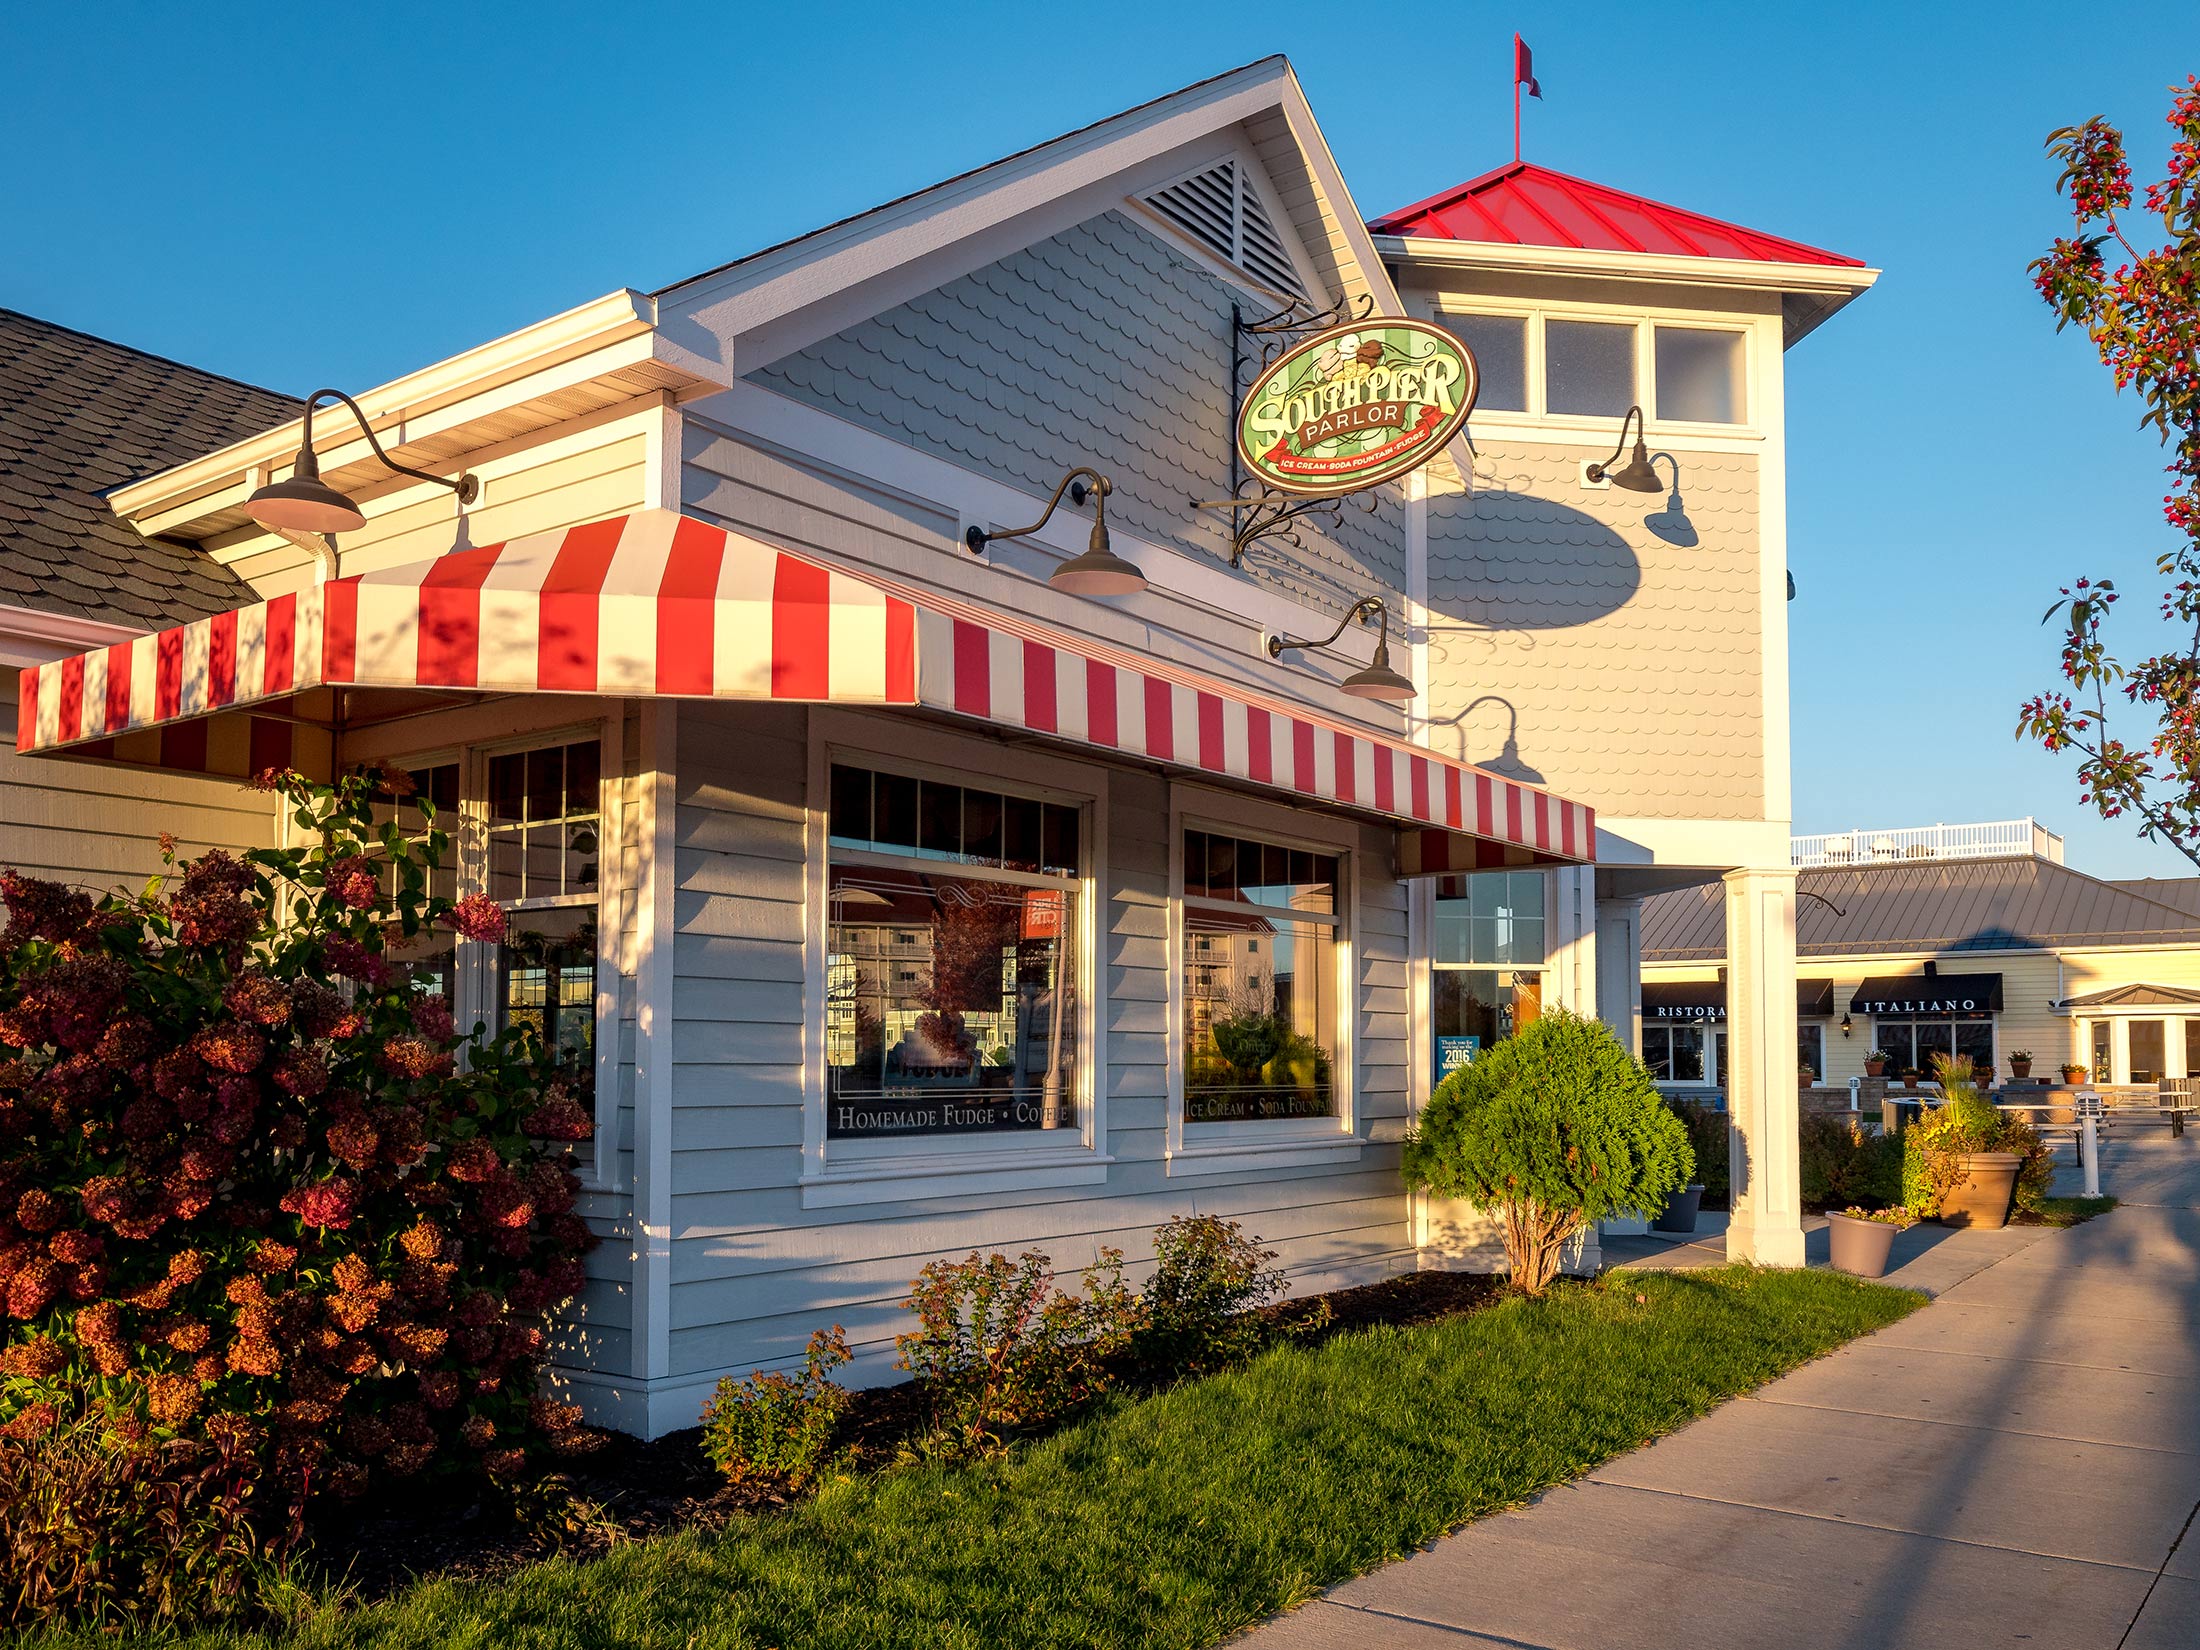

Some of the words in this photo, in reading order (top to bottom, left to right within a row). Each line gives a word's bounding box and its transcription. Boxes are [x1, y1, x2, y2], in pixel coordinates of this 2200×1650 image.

[1250, 379, 1363, 462] SOUTH
[1365, 353, 1461, 416] PIER
[1305, 404, 1398, 442] PARLOR
[1281, 459, 1295, 468] ICE
[1352, 447, 1394, 467] FOUNTAIN
[1396, 429, 1427, 450] FUDGE
[1863, 999, 1976, 1013] ITALIANO
[1445, 1049, 1470, 1063] 2016
[837, 1106, 937, 1130] HOMEMADE
[943, 1104, 995, 1126] FUDGE
[1185, 1099, 1203, 1117] ICE
[1207, 1098, 1245, 1116] CREAM
[1258, 1097, 1285, 1115] SODA
[1288, 1096, 1335, 1113] FOUNTAIN
